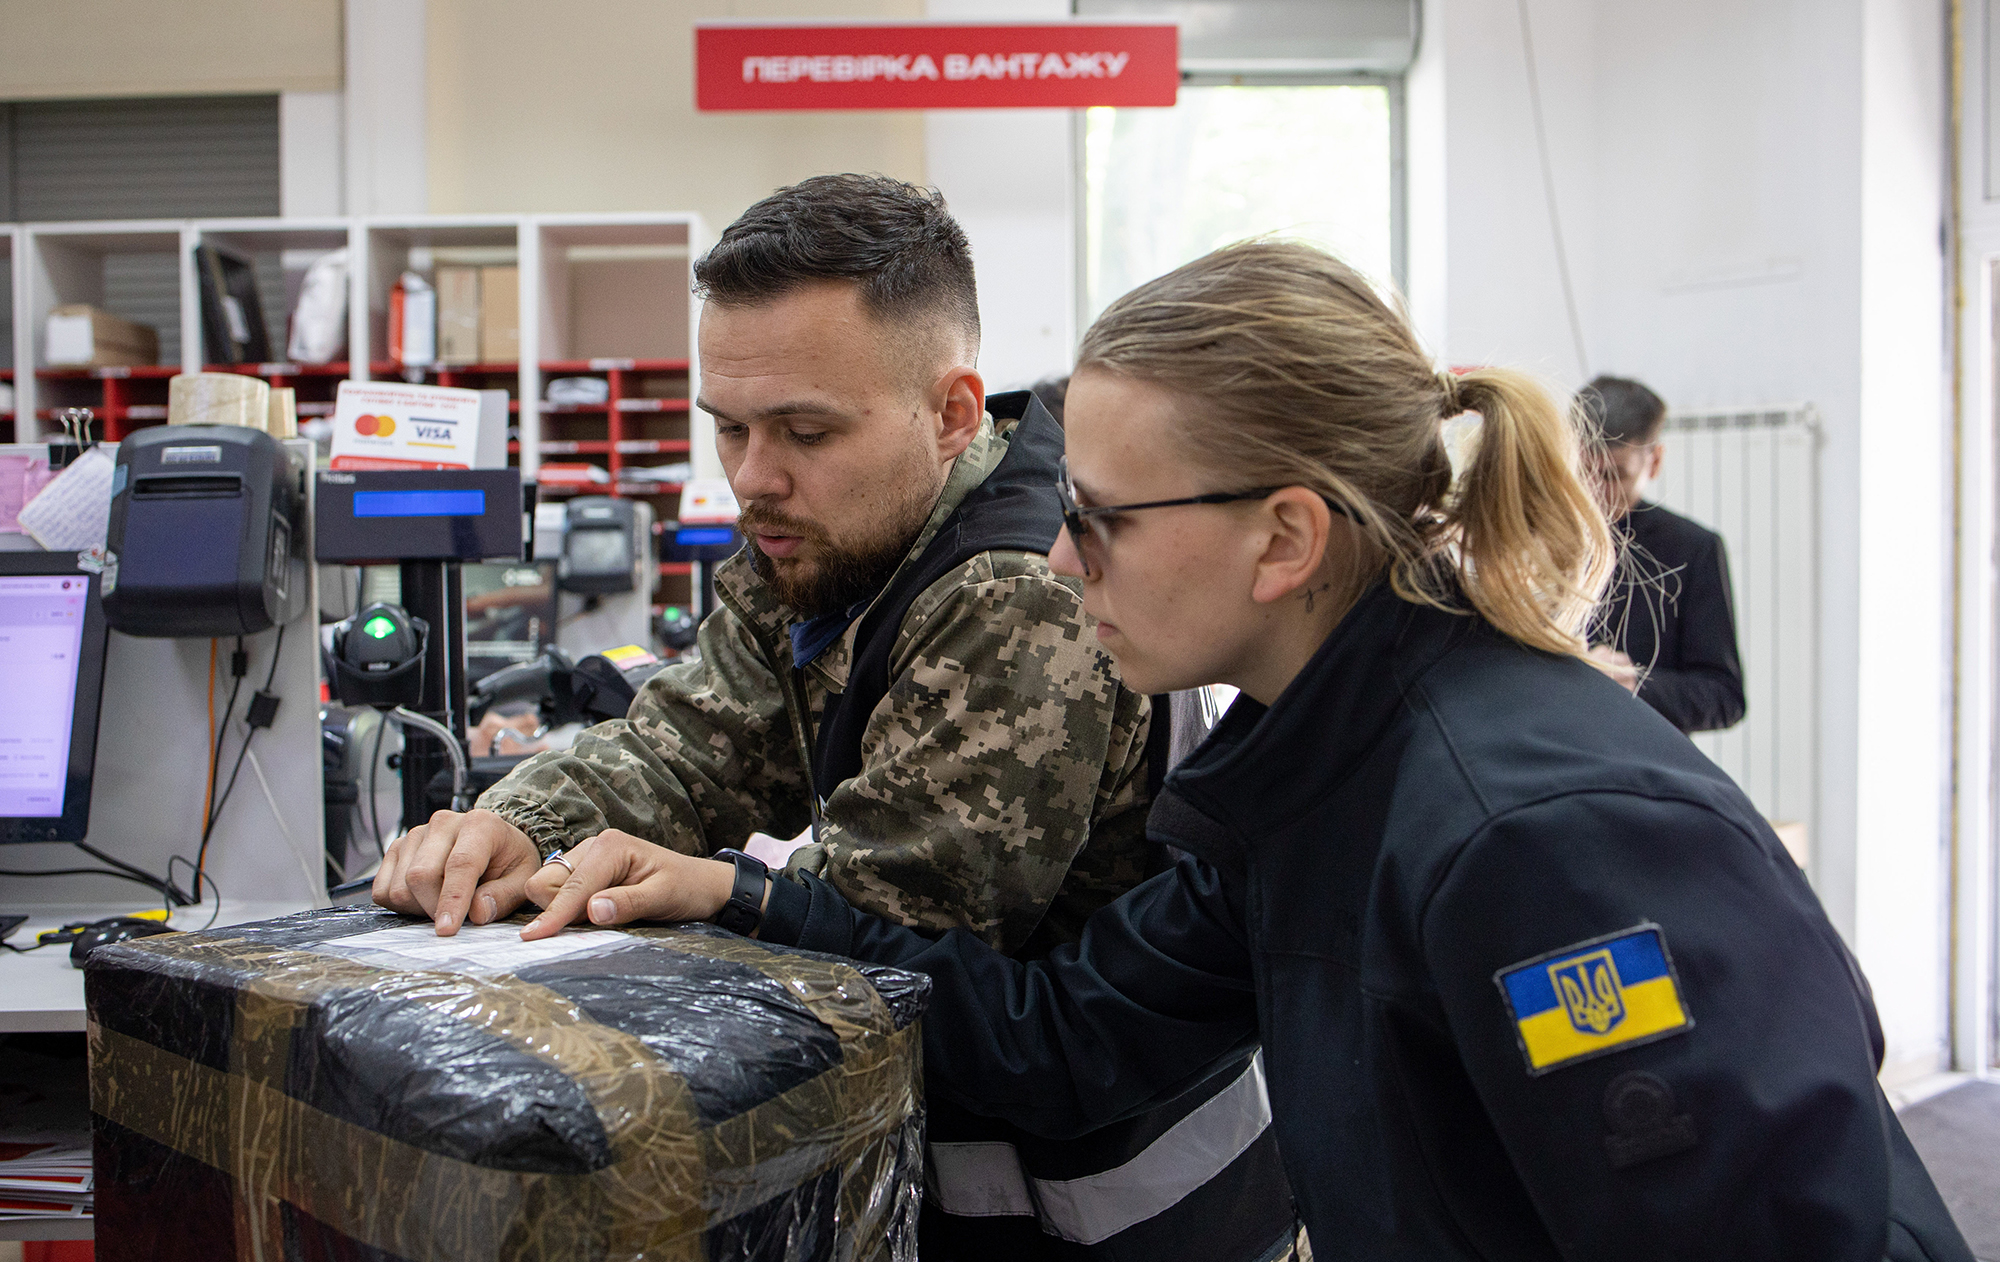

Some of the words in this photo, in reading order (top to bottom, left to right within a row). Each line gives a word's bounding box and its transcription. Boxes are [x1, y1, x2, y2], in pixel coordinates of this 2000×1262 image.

[742, 54, 940, 83] ПЕРЕВІРКА
[943, 51, 1130, 81] ВАНТАЖУ
[416, 425, 452, 440] VISA
